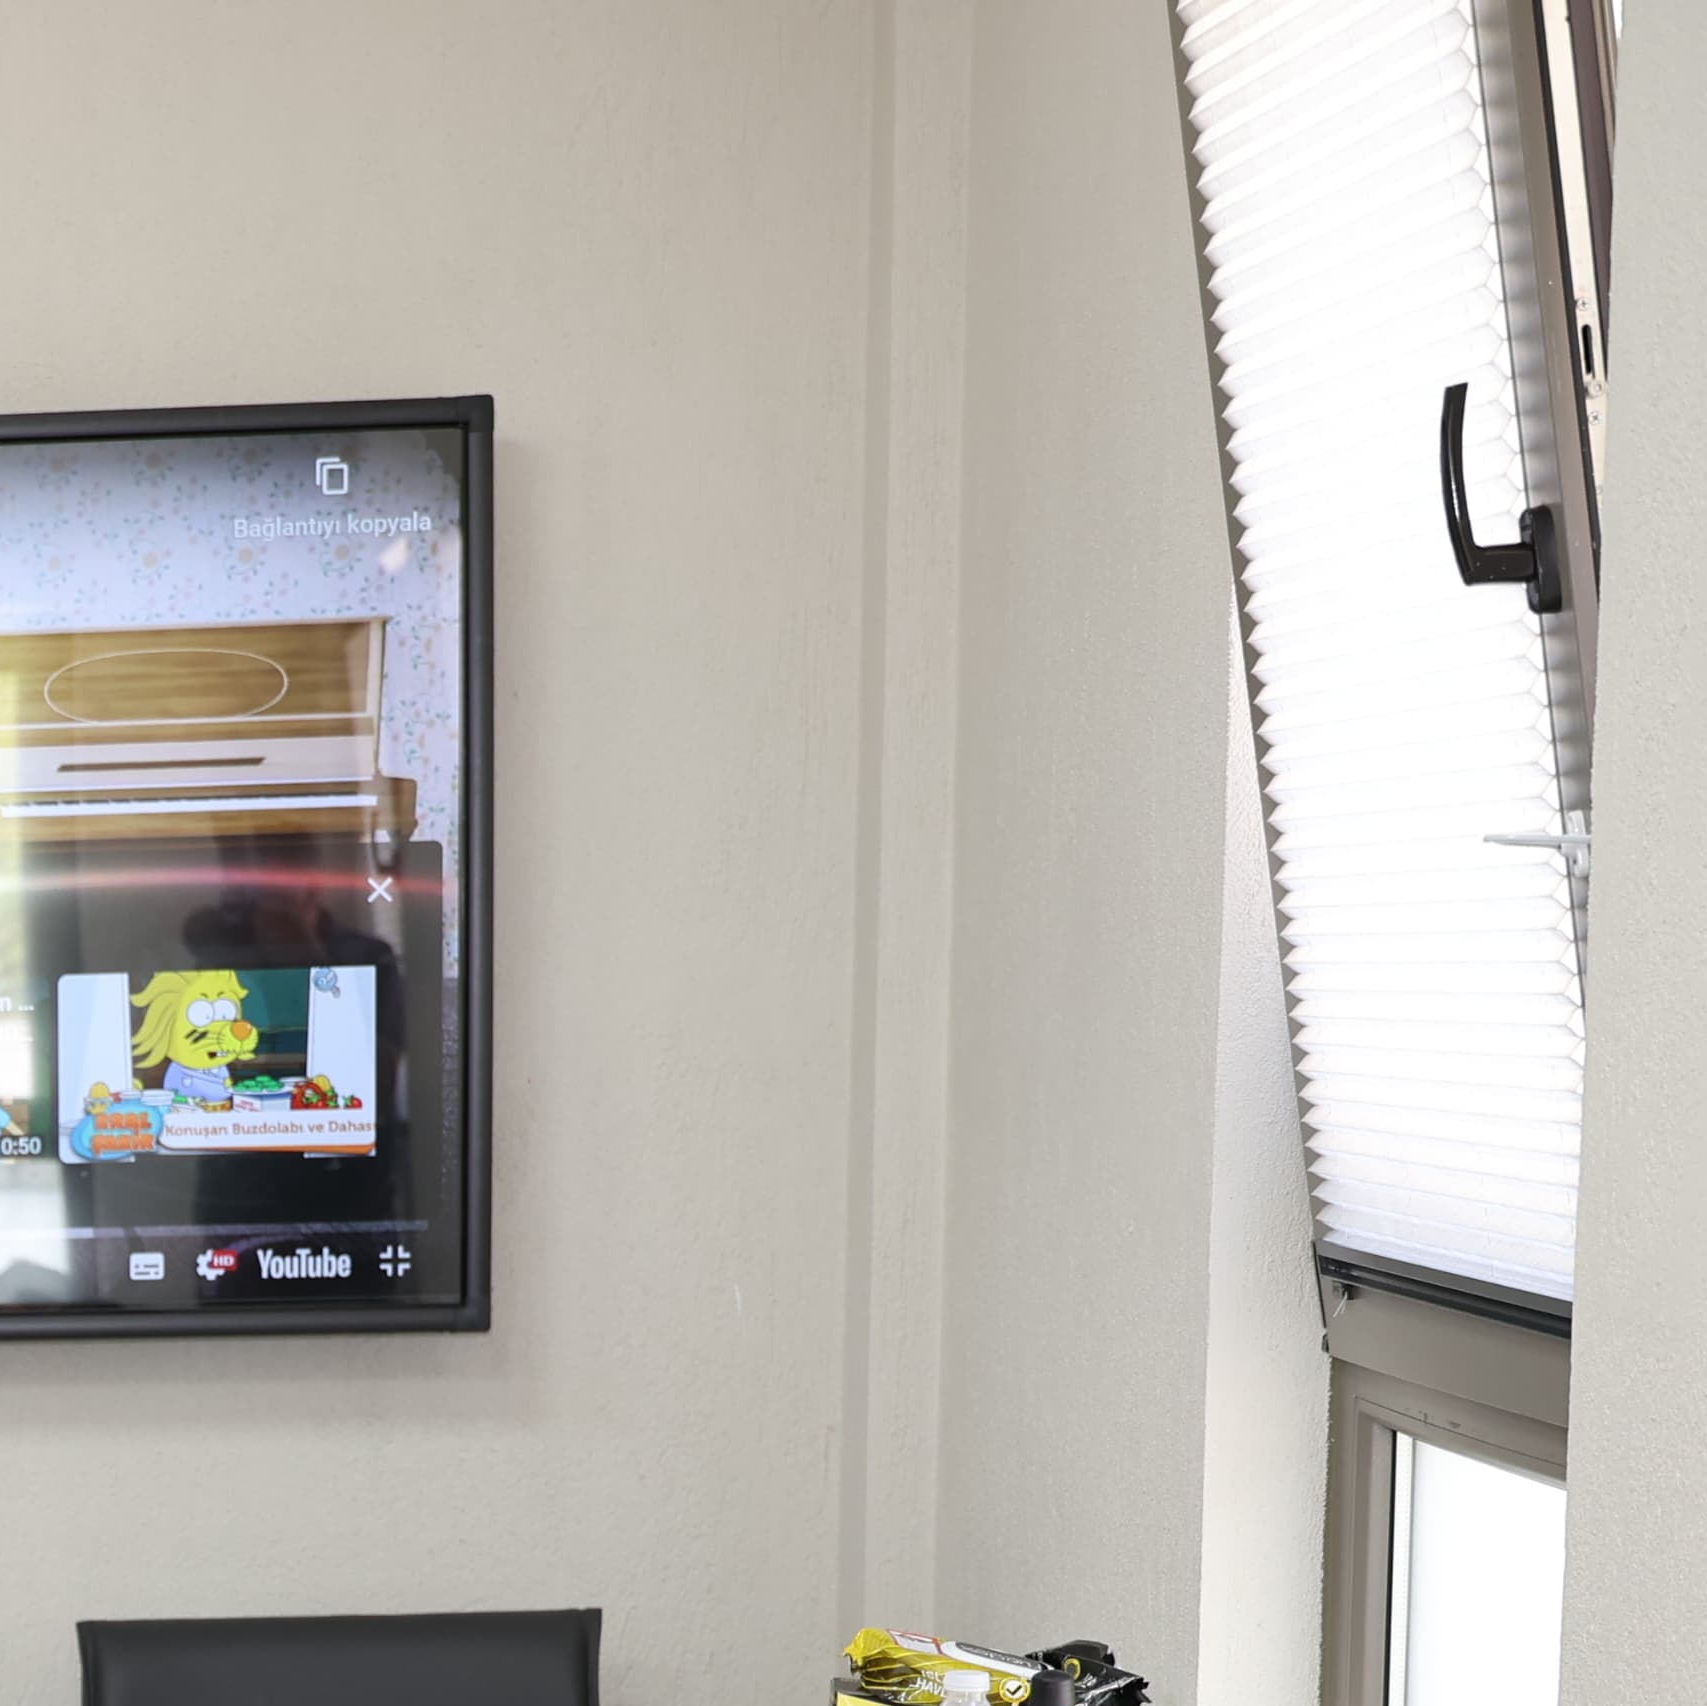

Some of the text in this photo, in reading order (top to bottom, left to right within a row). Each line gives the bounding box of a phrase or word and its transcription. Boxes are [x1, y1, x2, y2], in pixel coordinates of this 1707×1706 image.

[234, 511, 432, 542] Bağlantıyı kopyala
[165, 1124, 228, 1139] Konuşan
[232, 1122, 303, 1136] Buzdolabı
[307, 1123, 324, 1134] ve
[213, 1255, 235, 1268] HD
[256, 1246, 352, 1279] YouTube
